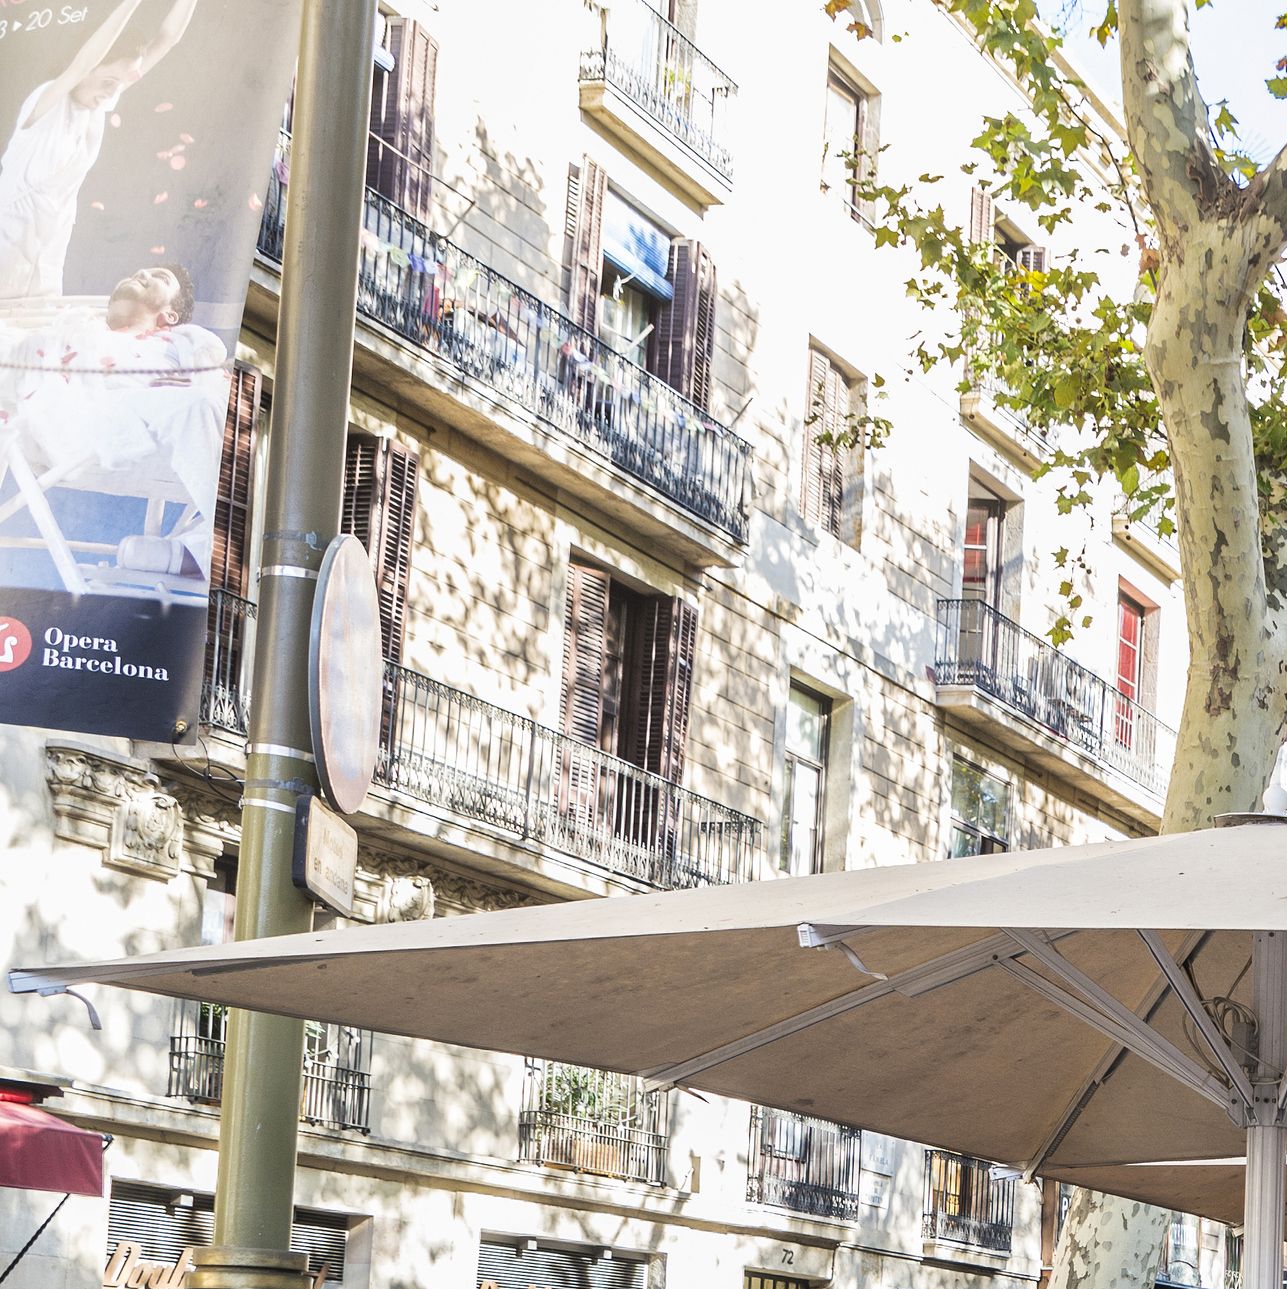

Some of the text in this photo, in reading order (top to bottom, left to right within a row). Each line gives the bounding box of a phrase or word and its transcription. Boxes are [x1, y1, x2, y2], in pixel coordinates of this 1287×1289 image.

[25, 8, 53, 31] 20
[57, 5, 88, 25] Set
[44, 627, 118, 653] Opera
[42, 648, 169, 681] Barcelona
[781, 1248, 795, 1265] 72
